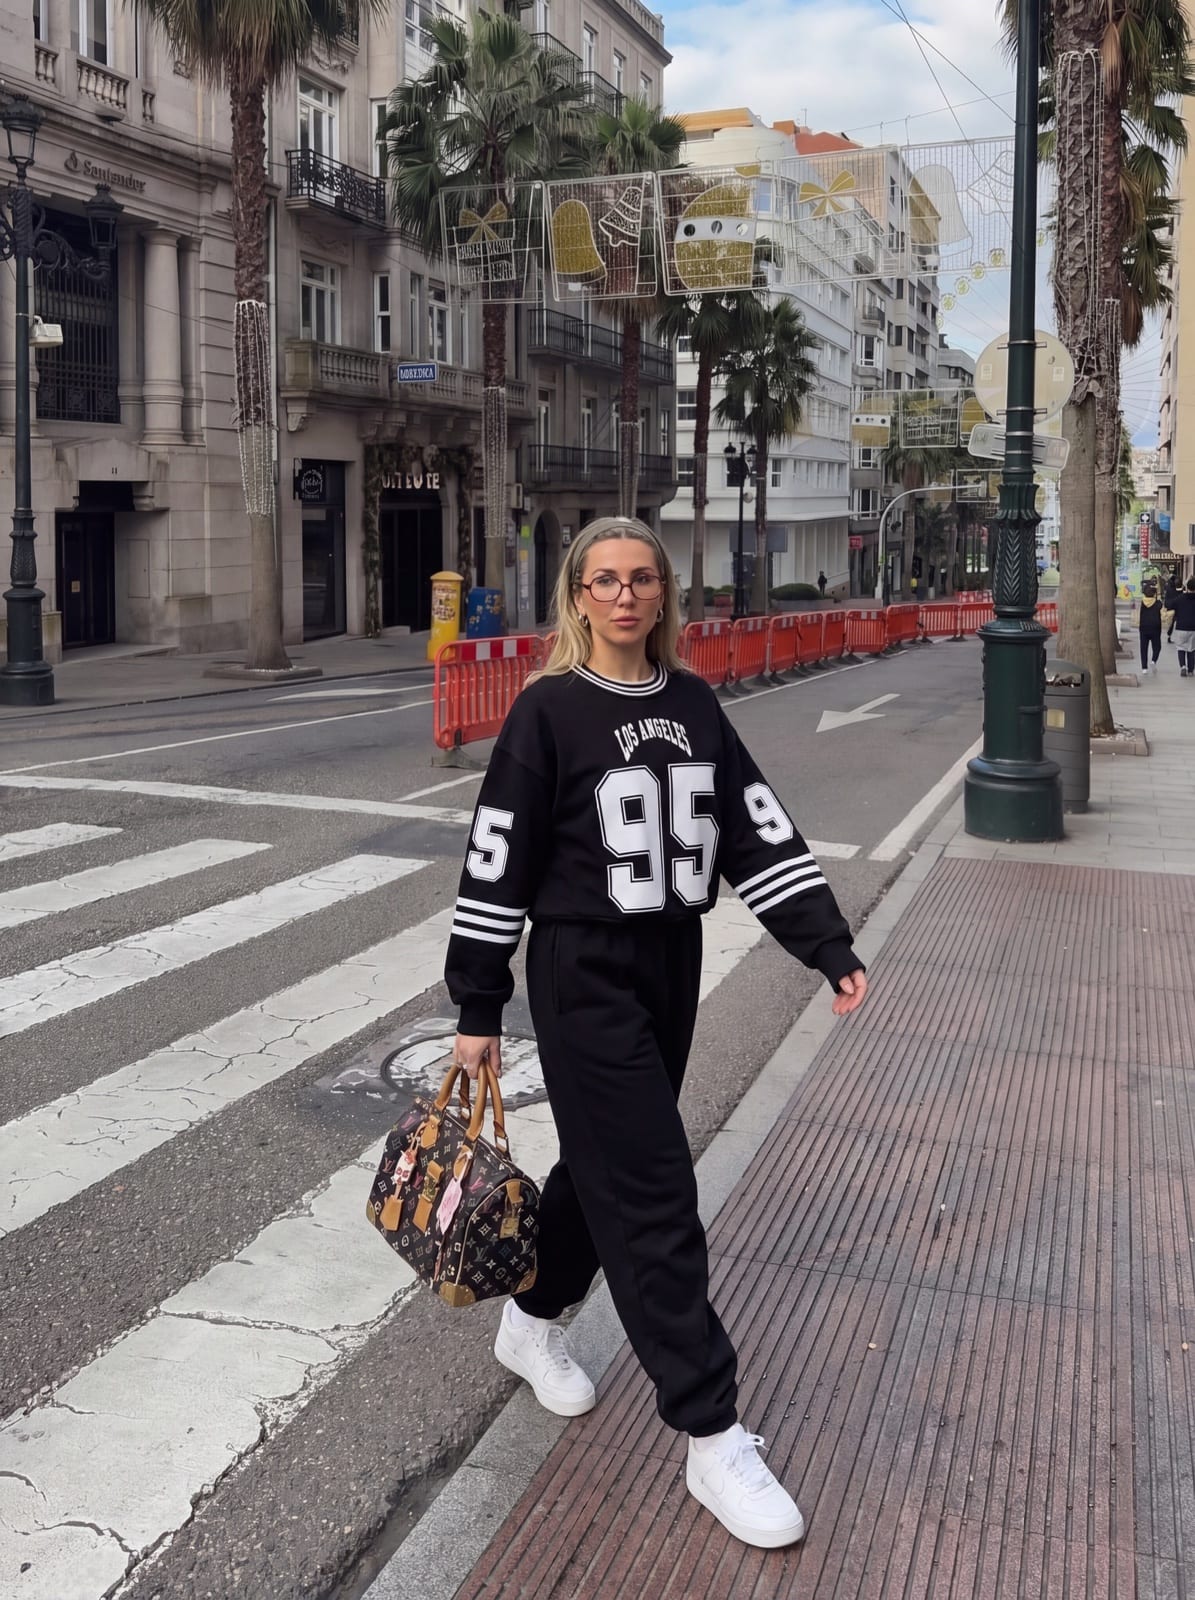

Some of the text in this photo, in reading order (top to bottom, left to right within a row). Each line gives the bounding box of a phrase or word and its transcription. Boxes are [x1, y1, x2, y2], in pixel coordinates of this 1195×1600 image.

[83, 159, 146, 192] Santander
[613, 717, 693, 763] LOS ANGELES
[465, 804, 515, 883] 5
[595, 762, 720, 914] 95
[743, 782, 794, 846] 9
